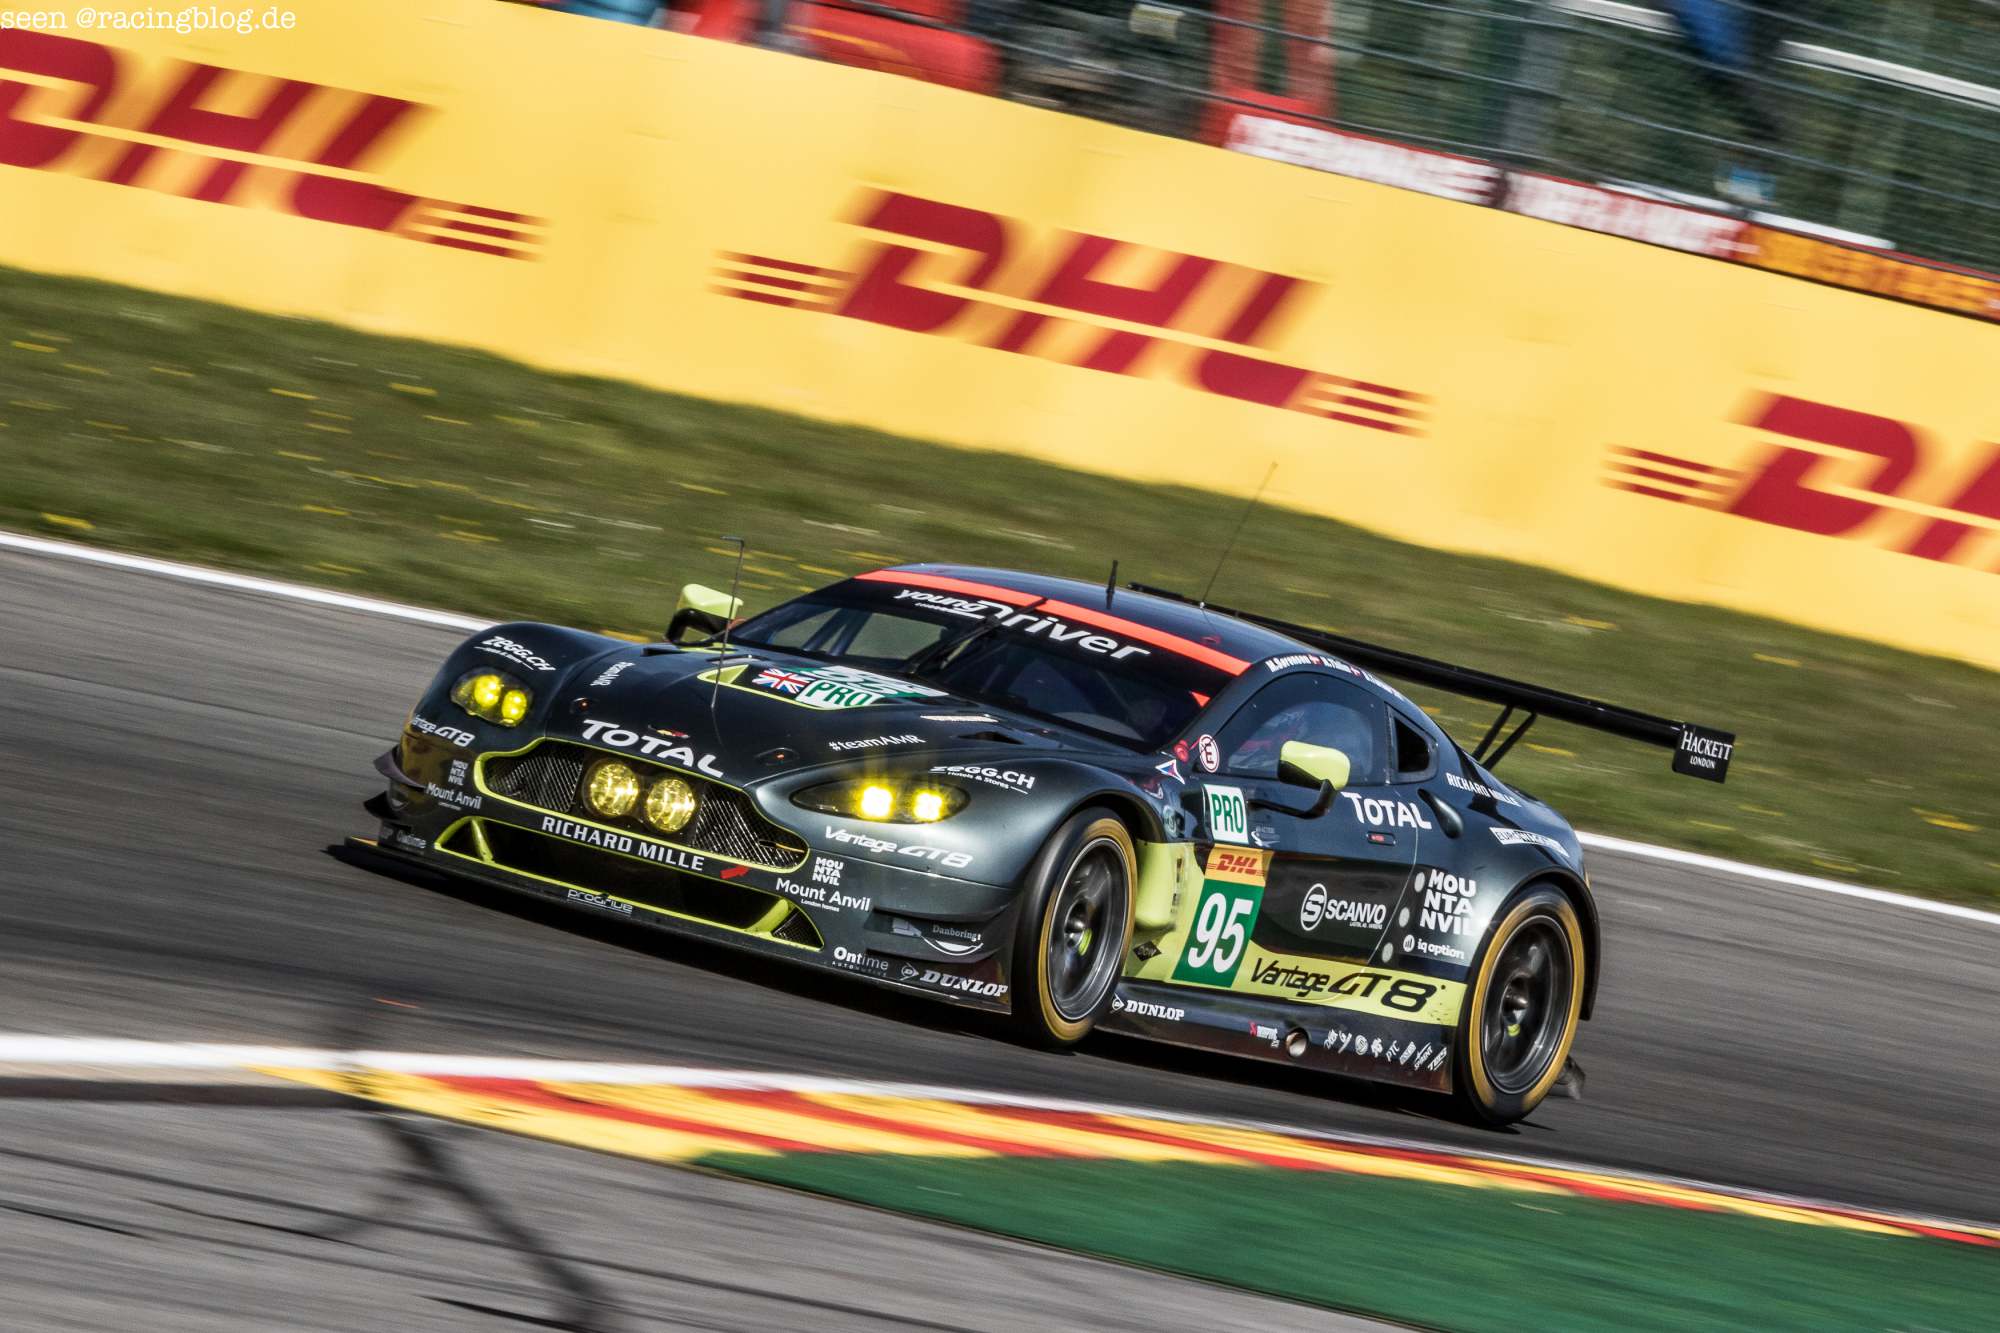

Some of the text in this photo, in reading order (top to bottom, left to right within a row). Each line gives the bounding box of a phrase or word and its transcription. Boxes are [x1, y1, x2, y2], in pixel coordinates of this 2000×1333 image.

[836, 186, 1318, 409] DHL
[805, 681, 873, 707] PRO
[434, 726, 476, 747] GT8
[581, 719, 724, 779] TOTAL
[828, 733, 926, 752] #teamAMR
[1680, 730, 1733, 761] HACKETT
[1689, 755, 1716, 769] LONDON
[425, 782, 455, 801] Mount
[455, 791, 482, 810] Anvil
[1446, 772, 1491, 798] RICHARD
[1210, 793, 1245, 834] PRO
[1340, 791, 1433, 830] TOTAL
[541, 815, 705, 872] RICHARD MILLE
[825, 825, 974, 869] Vantage GT8
[813, 866, 842, 878] NTA
[815, 856, 844, 870] MOU
[1216, 854, 1258, 875] DHL
[775, 877, 871, 912] Mount Anvil
[1428, 868, 1477, 898] MOU
[1325, 898, 1387, 924] SCANVO
[1424, 888, 1474, 916] NTA
[1187, 892, 1254, 973] 95
[1419, 908, 1474, 936] NVIL
[833, 946, 889, 971] Ontime
[1428, 943, 1465, 960] option
[919, 969, 1009, 997] DUNLOP
[1250, 957, 1438, 1013] Vantage GT8
[1123, 999, 1185, 1021] DUNLOP
